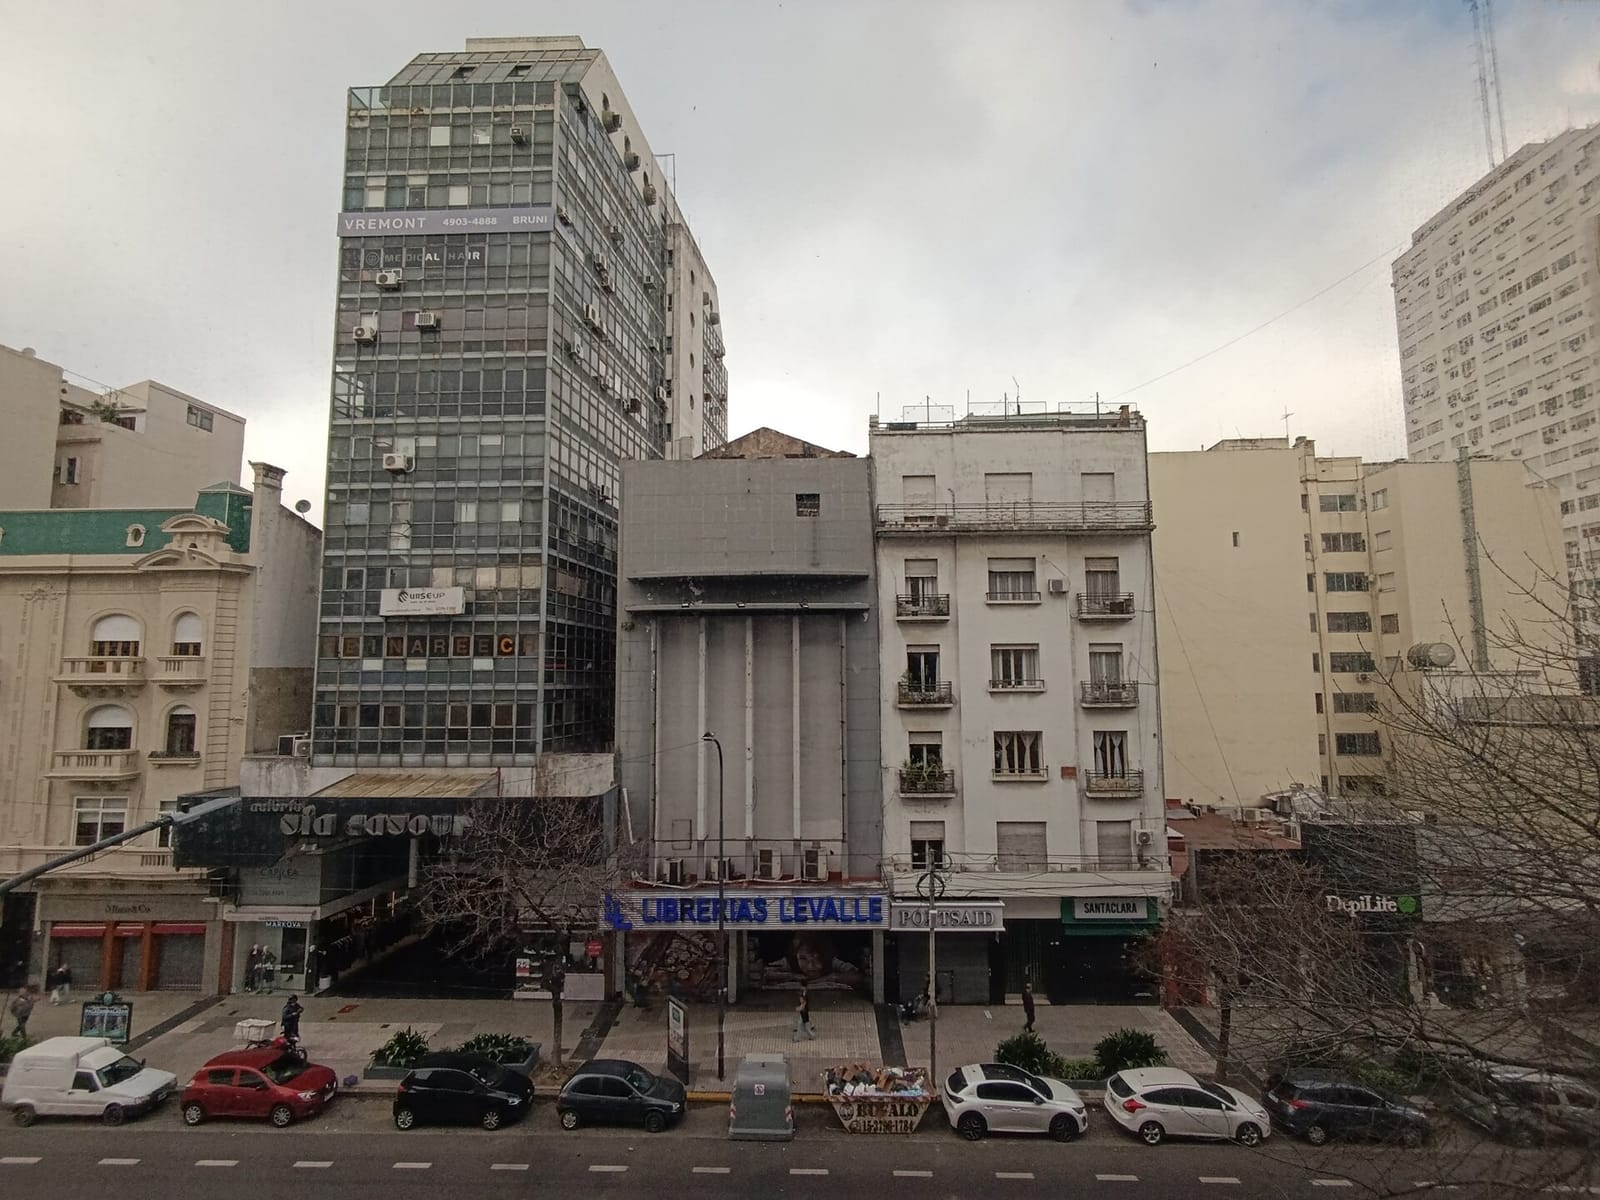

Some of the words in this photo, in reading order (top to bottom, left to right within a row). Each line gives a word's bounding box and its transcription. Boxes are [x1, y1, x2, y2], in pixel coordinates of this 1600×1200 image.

[344, 217, 426, 230] VREMONT
[442, 217, 497, 226] 4903-4888
[512, 215, 548, 225] BRUNI
[448, 251, 481, 261] HAIR
[642, 897, 769, 923] LIBRERIAS
[779, 897, 884, 923] LEVALLE
[1084, 902, 1138, 914] SANTACLARA
[900, 910, 994, 927] POTSAID
